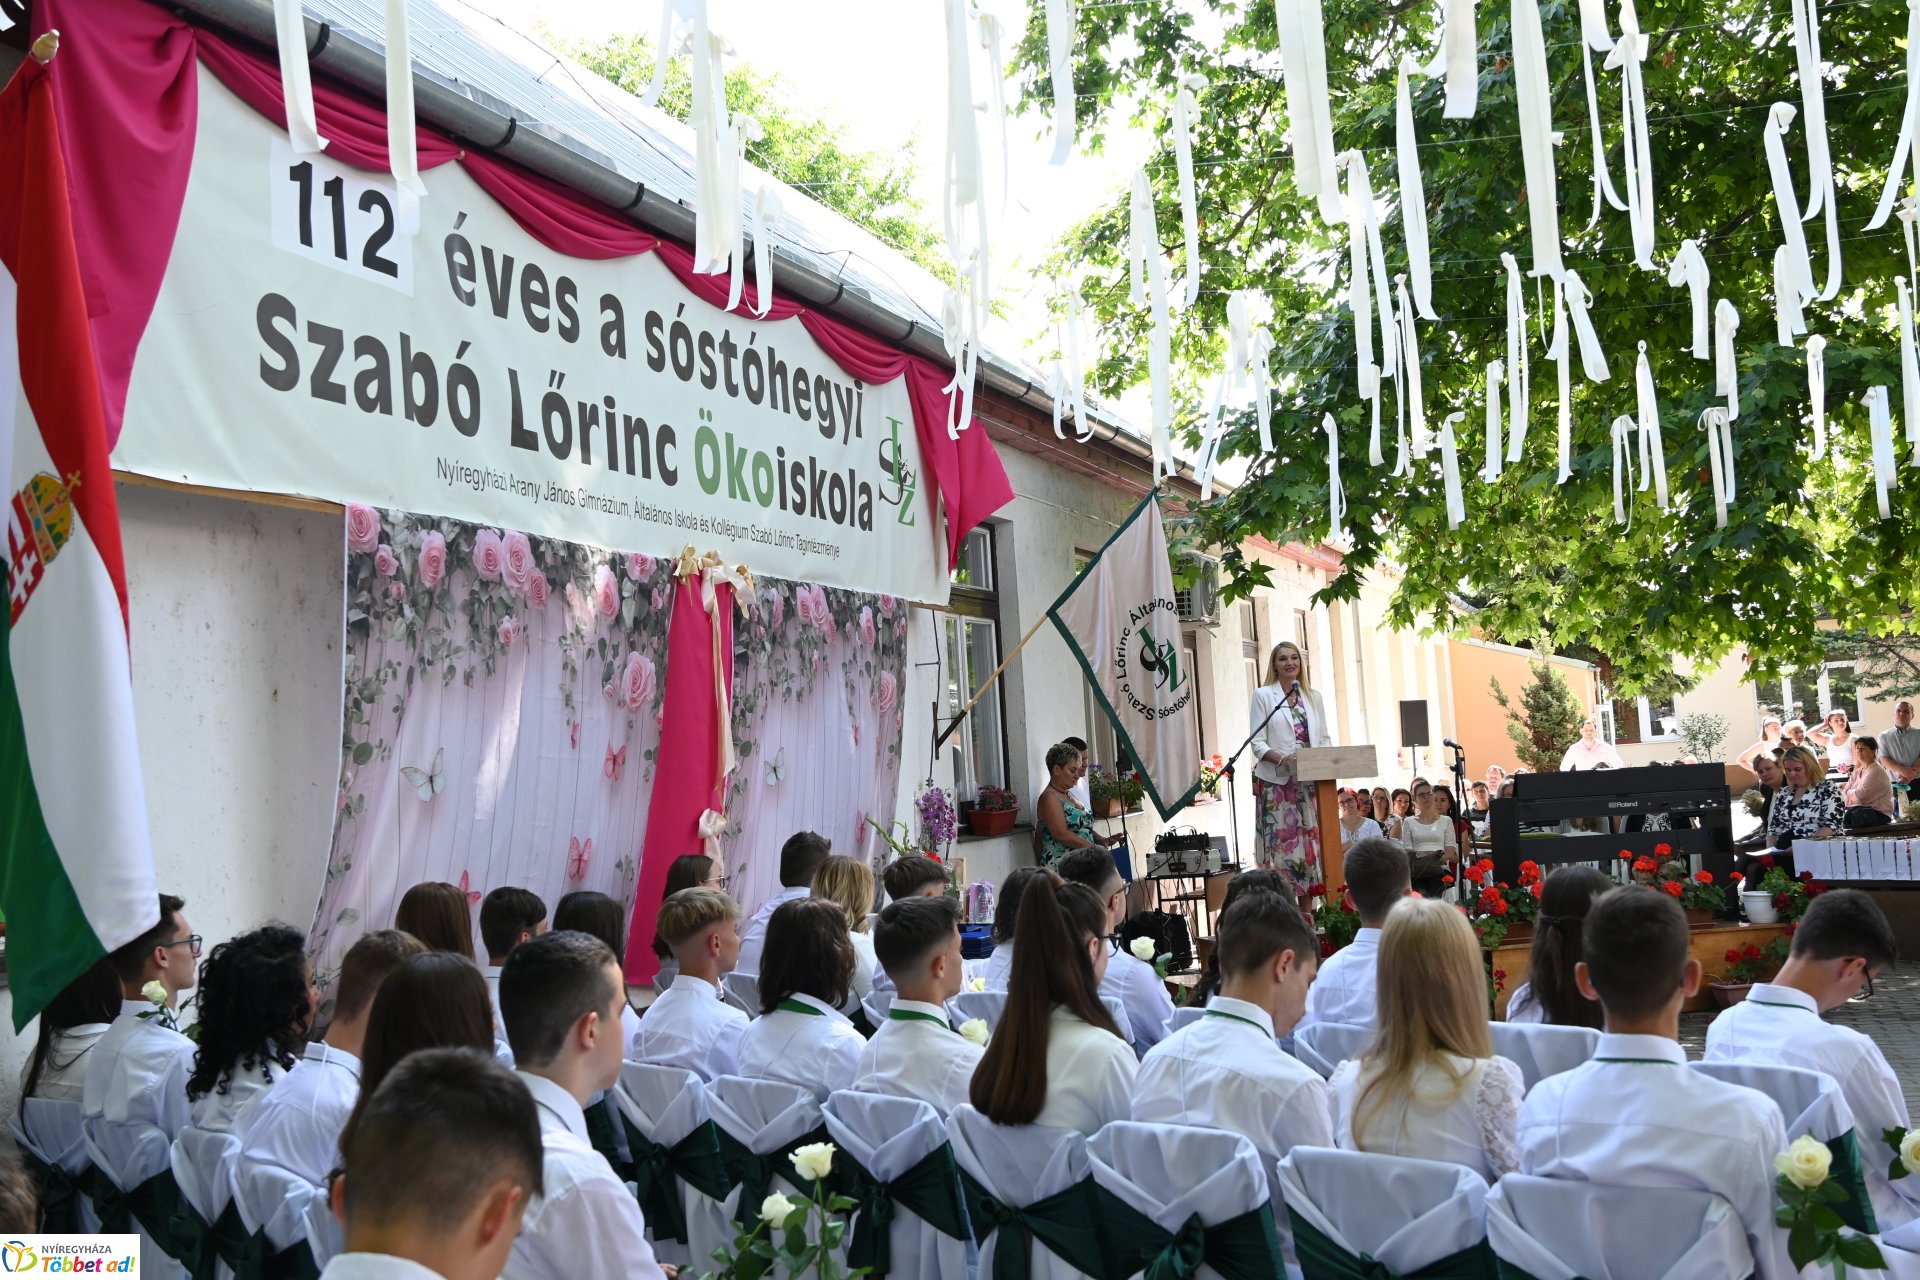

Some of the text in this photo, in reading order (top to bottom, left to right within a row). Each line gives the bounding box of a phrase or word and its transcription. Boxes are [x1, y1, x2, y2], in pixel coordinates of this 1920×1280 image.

[288, 160, 864, 446] 112 éves a sóstóhegyi
[255, 292, 874, 532] Szabó Lőrinc Ökoiskola
[436, 457, 840, 560] Nyíregyházi Arany János Gimnázium, Általános Iskola és Kollégium Szabó Lőrinc Tagintézménye
[1115, 595, 1178, 720] Szabó Lőrinc Áltaános
